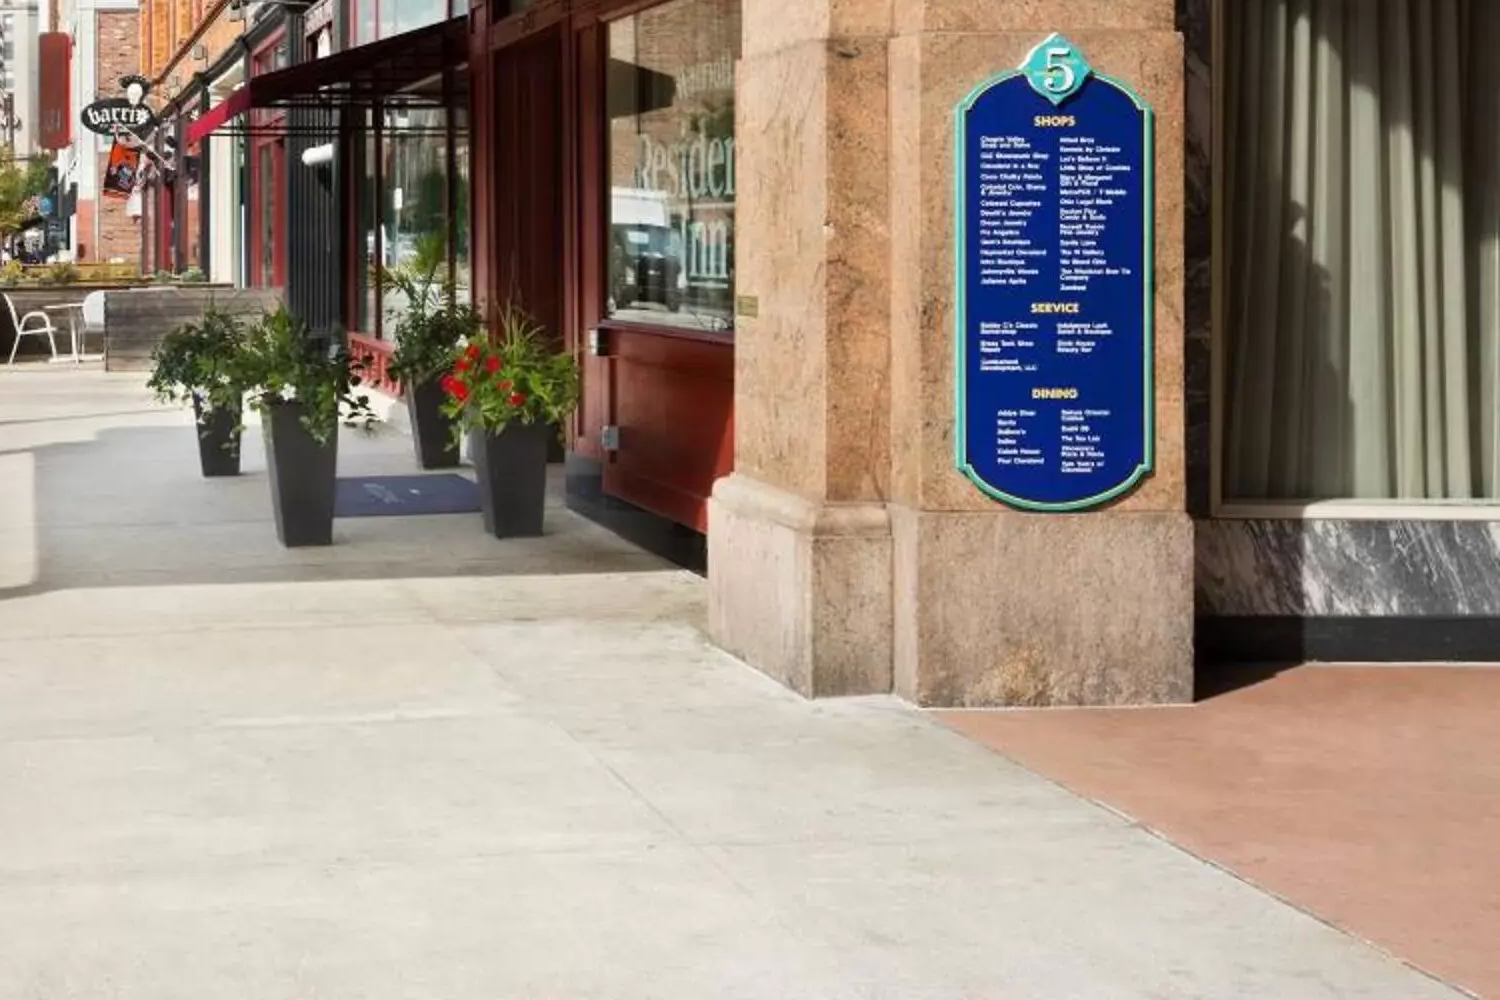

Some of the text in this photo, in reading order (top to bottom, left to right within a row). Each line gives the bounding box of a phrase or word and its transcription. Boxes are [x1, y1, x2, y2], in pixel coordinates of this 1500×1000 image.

[1044, 47, 1075, 92] 5
[1034, 115, 1075, 127] SHOPS
[1031, 302, 1079, 313] SERVICE
[1032, 387, 1078, 399] DINING
